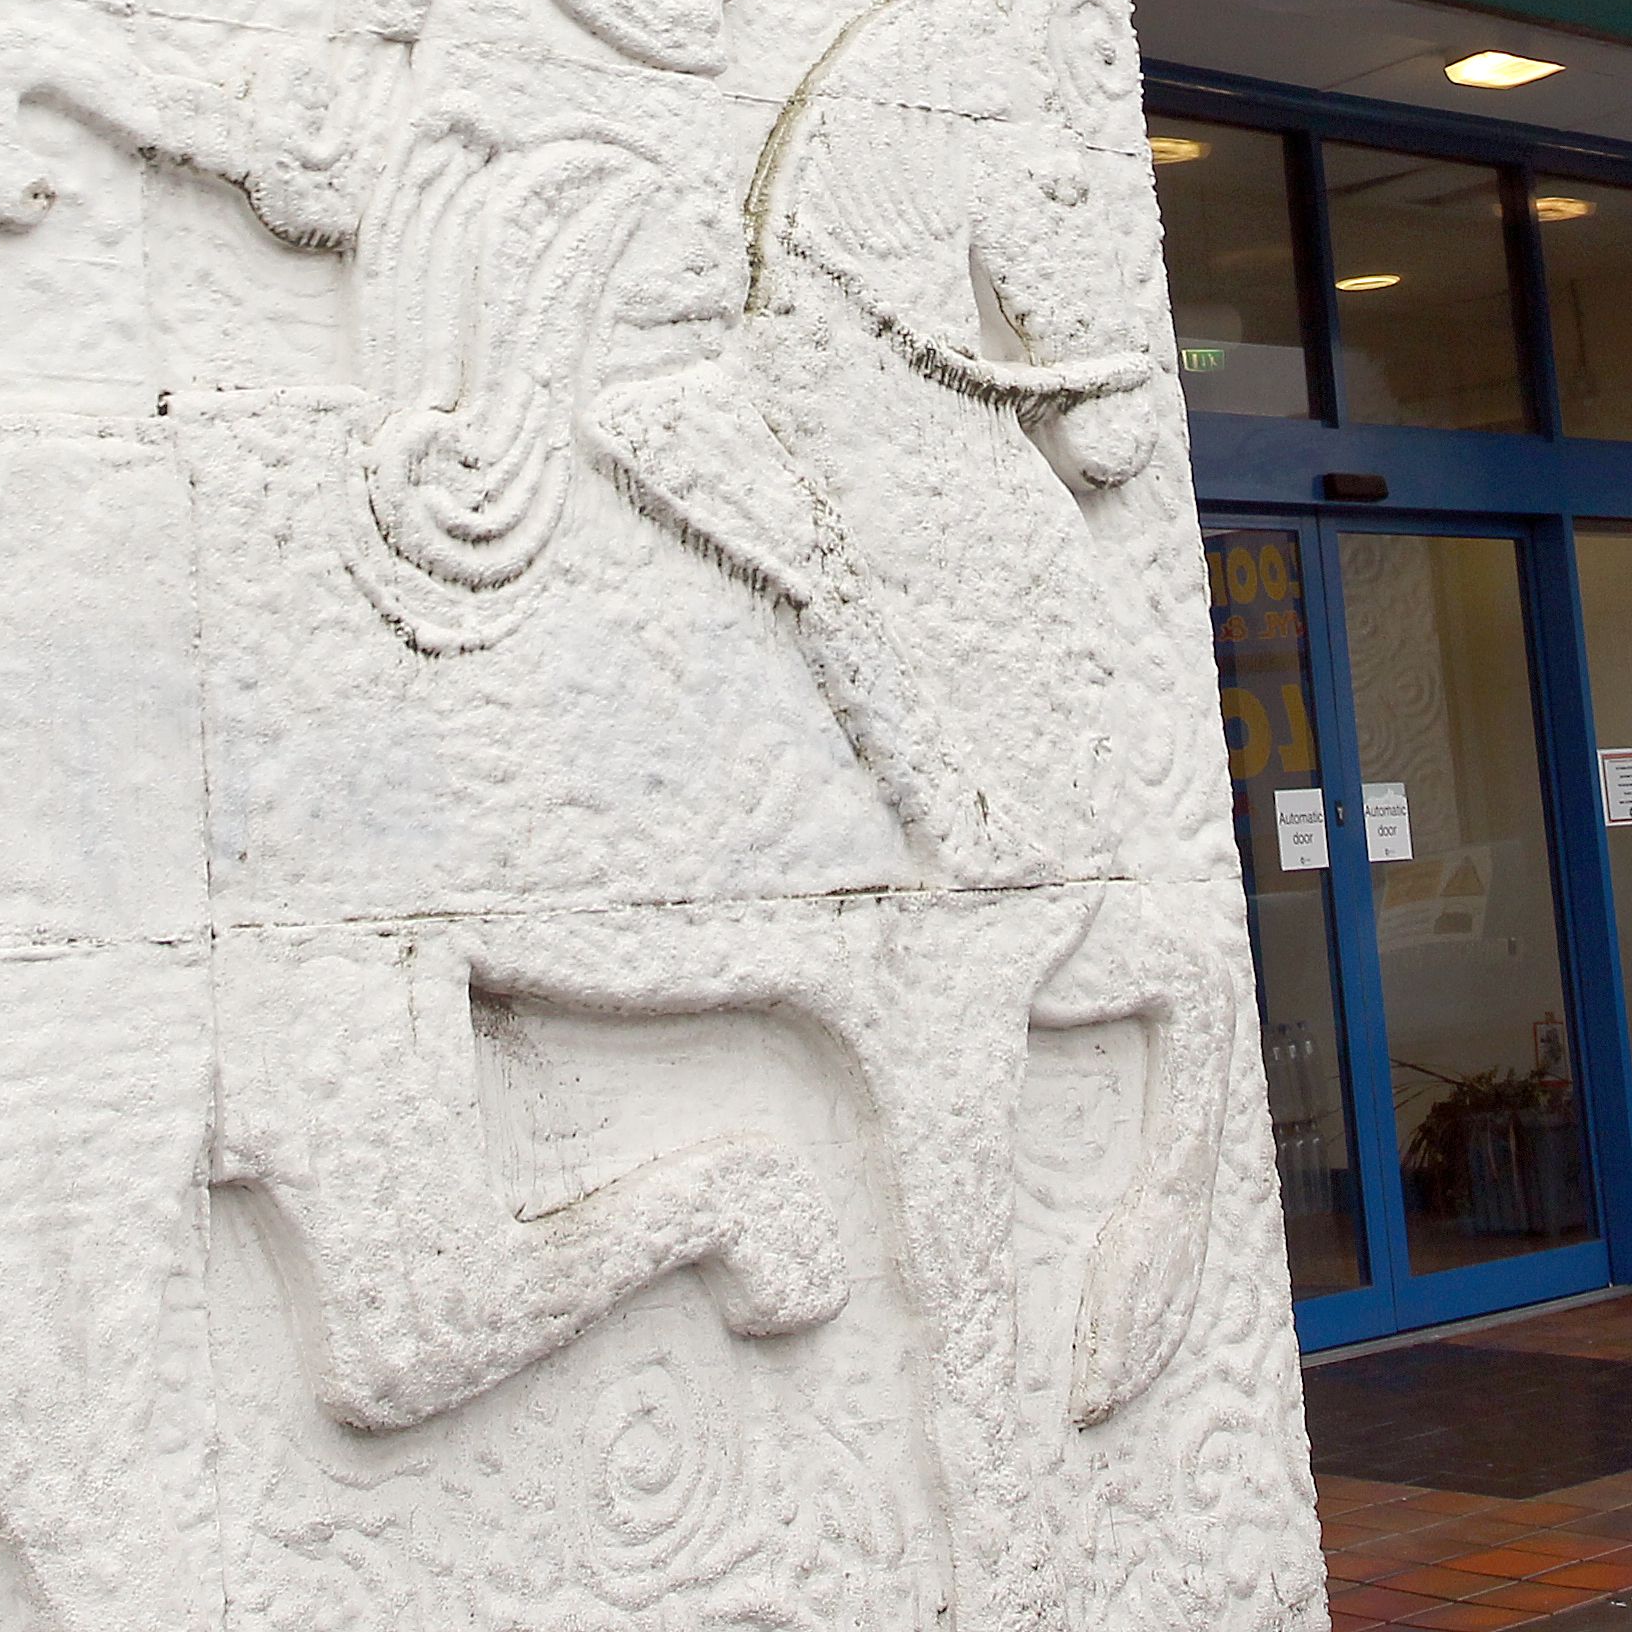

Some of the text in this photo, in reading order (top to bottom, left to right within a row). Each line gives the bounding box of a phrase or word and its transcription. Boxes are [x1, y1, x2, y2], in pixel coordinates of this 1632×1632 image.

[1365, 805, 1407, 816] Automatic
[1279, 812, 1324, 825] Automatic
[1378, 825, 1397, 837] door
[1293, 832, 1313, 845] door
